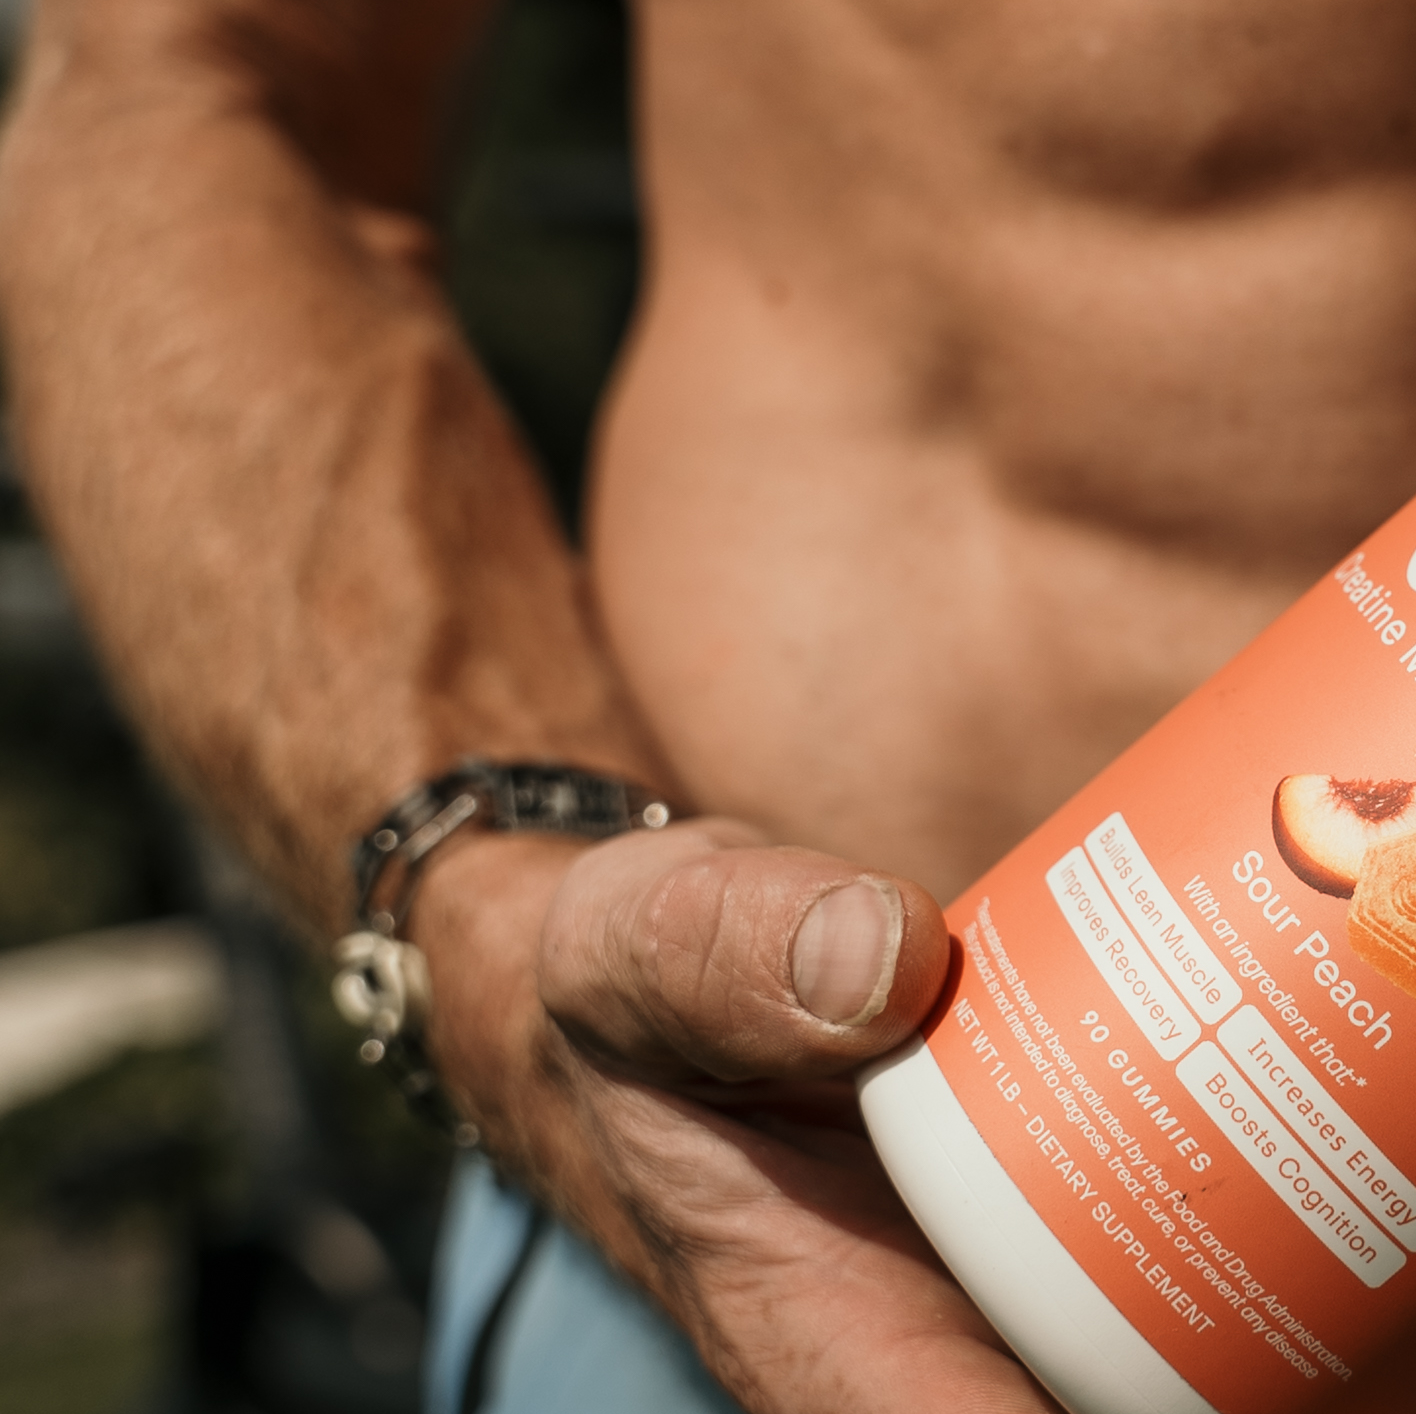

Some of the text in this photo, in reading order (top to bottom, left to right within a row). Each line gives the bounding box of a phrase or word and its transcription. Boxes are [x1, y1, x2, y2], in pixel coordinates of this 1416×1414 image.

[1334, 552, 1406, 645] Creatine
[1062, 863, 1182, 1041] Improves Recovery
[1099, 827, 1221, 1004] Builds Lean Muscle
[1184, 874, 1220, 921] With
[1212, 919, 1238, 946] an
[1231, 942, 1319, 1042] ingredient
[1232, 850, 1392, 1050] Sour Peach
[953, 998, 980, 1033] NET
[971, 1030, 999, 1063] WT
[990, 1061, 1005, 1076] 1
[996, 1072, 1021, 1102] LB
[967, 941, 996, 983] product
[986, 979, 1000, 996] is
[993, 991, 1014, 1015] not
[1005, 1010, 1053, 1072] intended
[1043, 1069, 1060, 1088] to
[1054, 1087, 1111, 1160] diagnose,
[1108, 1156, 1146, 1201] treat,
[1142, 1199, 1176, 1238] cure,
[1174, 1236, 1196, 1252] or
[1185, 1253, 1247, 1309] prevent
[1240, 1307, 1271, 1333] any
[1265, 1331, 1318, 1379] disease
[983, 924, 1019, 987] statements
[1011, 980, 1037, 1016] have
[1030, 1013, 1054, 1039] not
[1045, 1034, 1077, 1075] been
[1071, 1074, 1136, 1148] evaluated
[1125, 1143, 1149, 1166] by
[1143, 1164, 1169, 1193] the
[1164, 1190, 1208, 1233] Food
[1199, 1231, 1235, 1262] and
[1224, 1257, 1265, 1298] Drug
[1258, 1295, 1352, 1382] Administration.
[1026, 1115, 1098, 1201] DIETARY
[1080, 1010, 1212, 1172] 90 GUMMIES
[1248, 1038, 1346, 1151] Increases
[1205, 1072, 1376, 1263] Boosts Cognition
[1092, 1202, 1215, 1333] SUPPLEMENT
